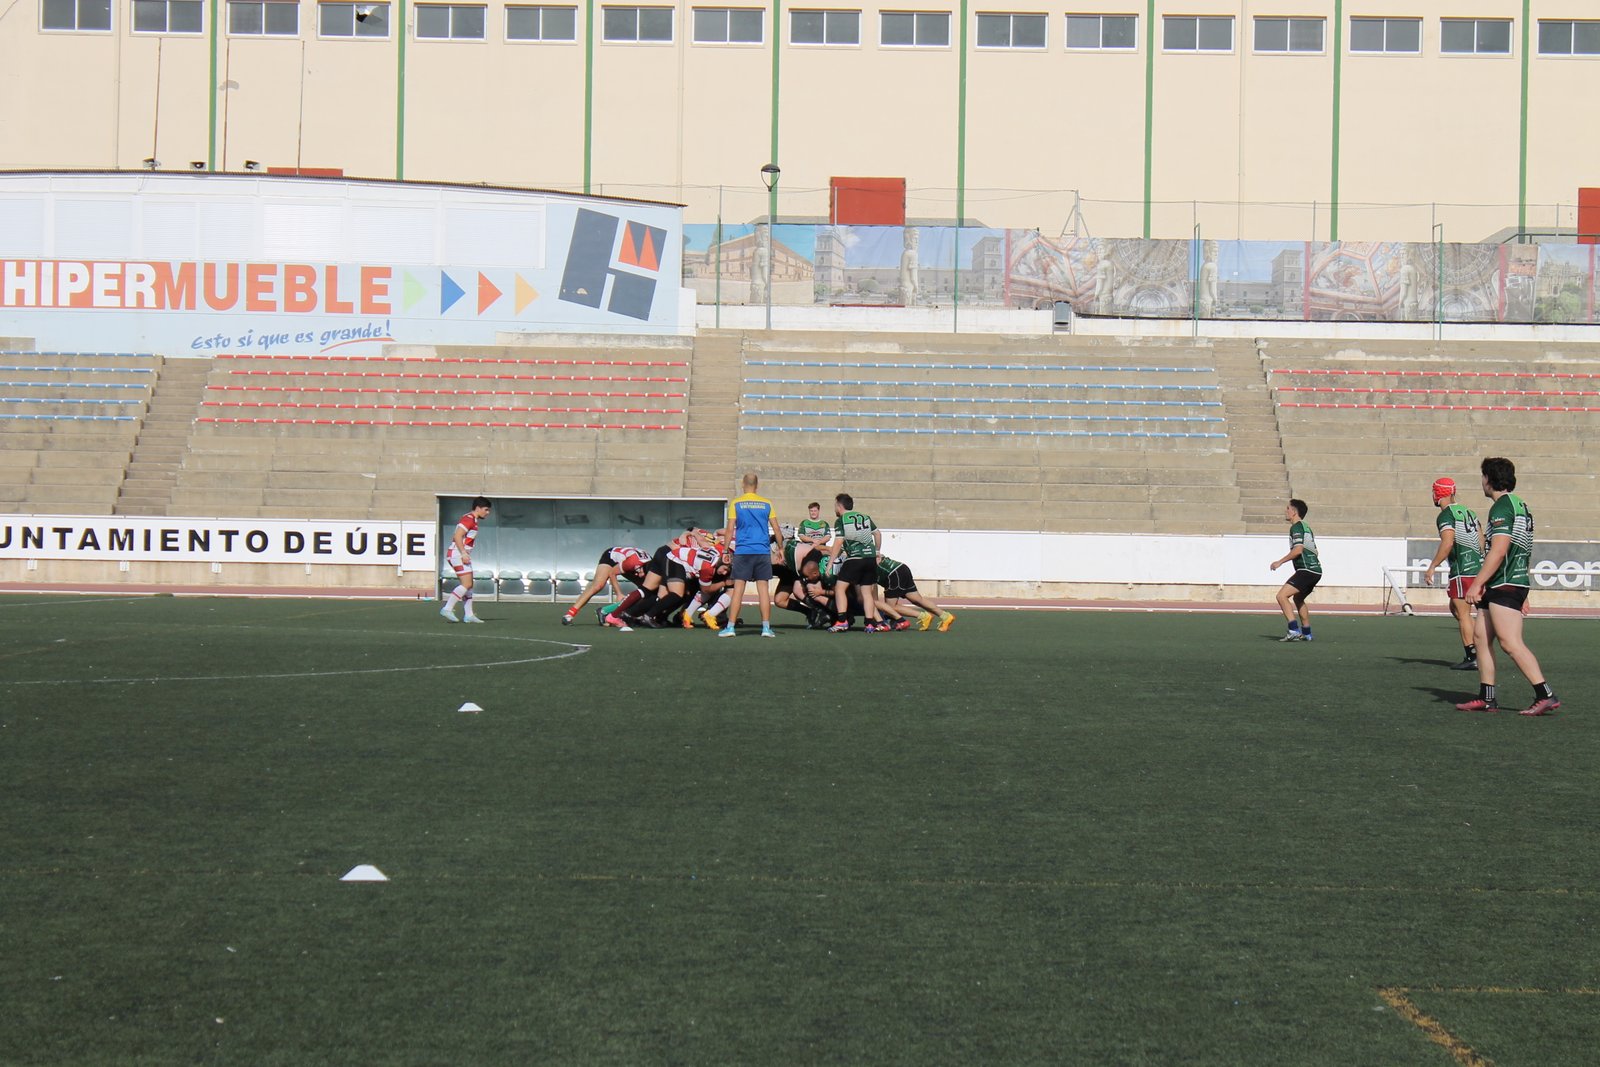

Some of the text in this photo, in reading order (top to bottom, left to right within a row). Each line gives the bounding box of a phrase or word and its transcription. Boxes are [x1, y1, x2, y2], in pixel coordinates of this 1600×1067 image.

[4, 261, 392, 314] HIPERMUEBLE
[191, 319, 392, 350] Esto si que es grande!
[848, 513, 869, 531] 22
[284, 530, 332, 554] DE
[346, 527, 437, 556] ÚBE
